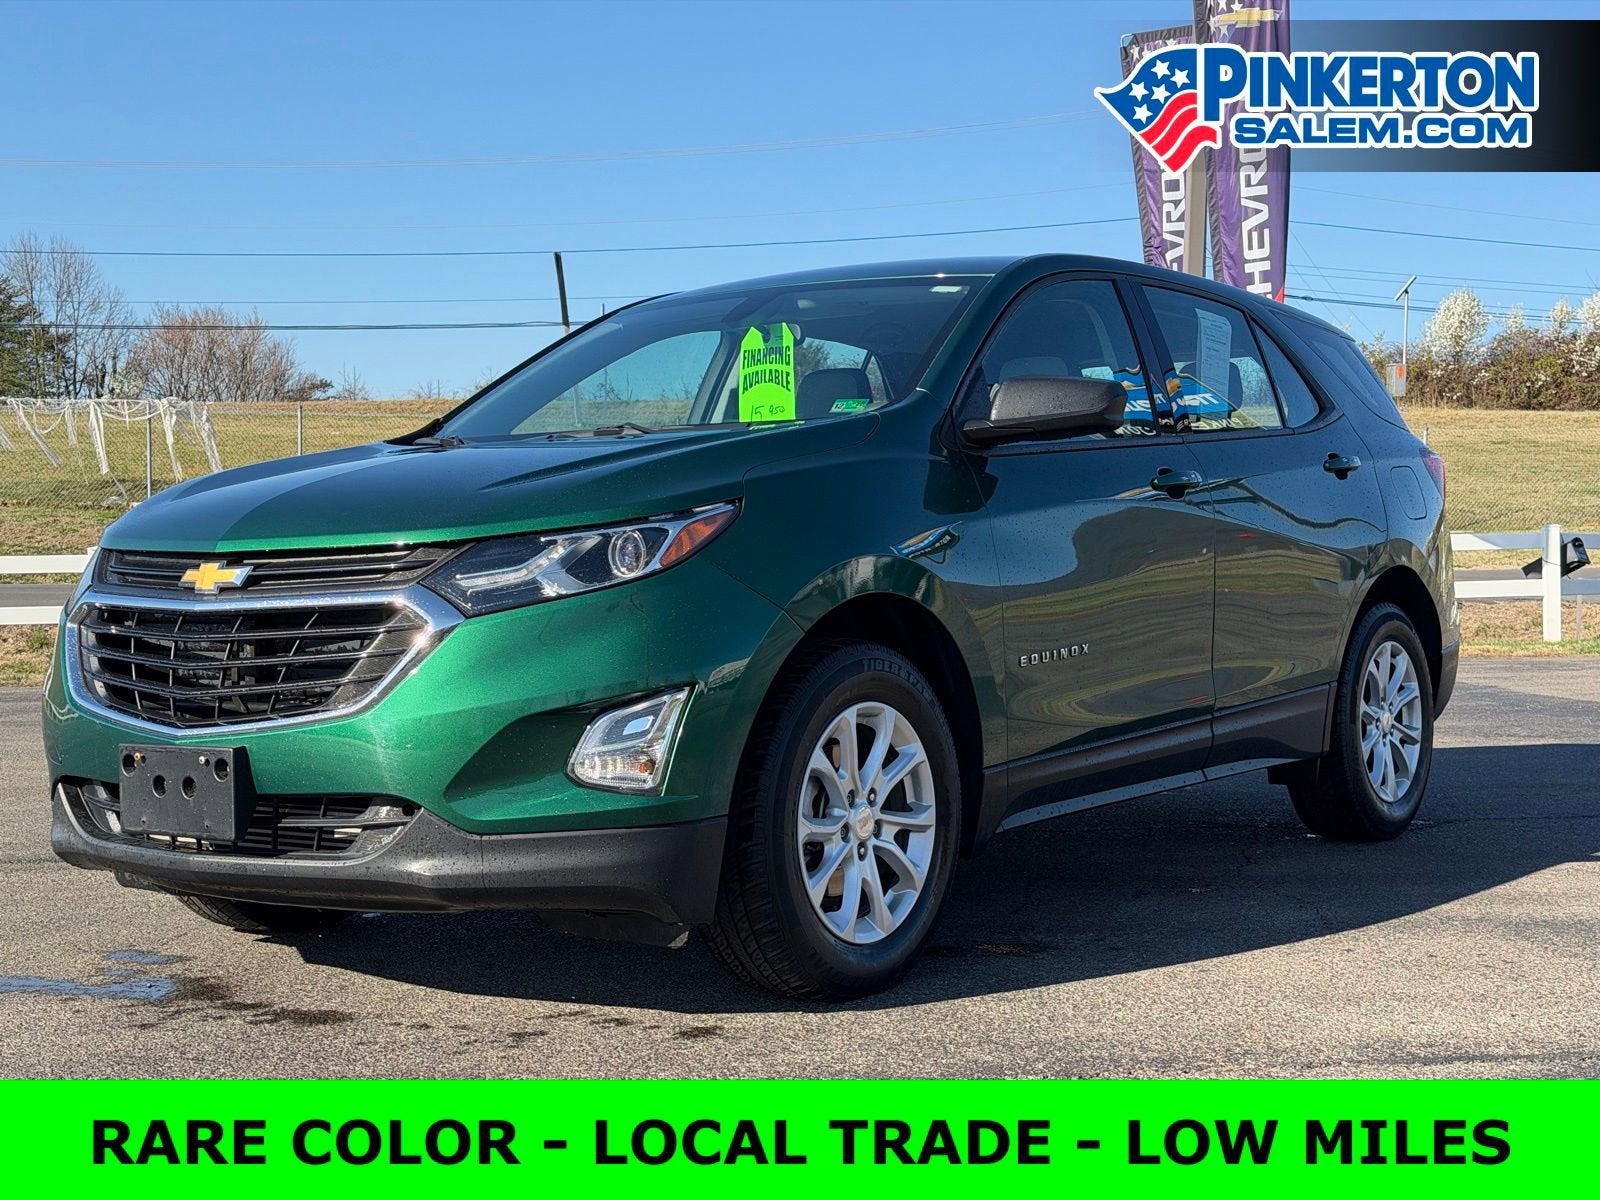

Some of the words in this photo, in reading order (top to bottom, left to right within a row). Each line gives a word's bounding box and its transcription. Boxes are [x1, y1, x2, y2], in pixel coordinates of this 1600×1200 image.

[742, 345, 791, 370] FINANCING
[742, 369, 791, 395] AVAILABLE
[863, 658, 900, 675] TIGER
[1019, 643, 1089, 668] EQUINOX
